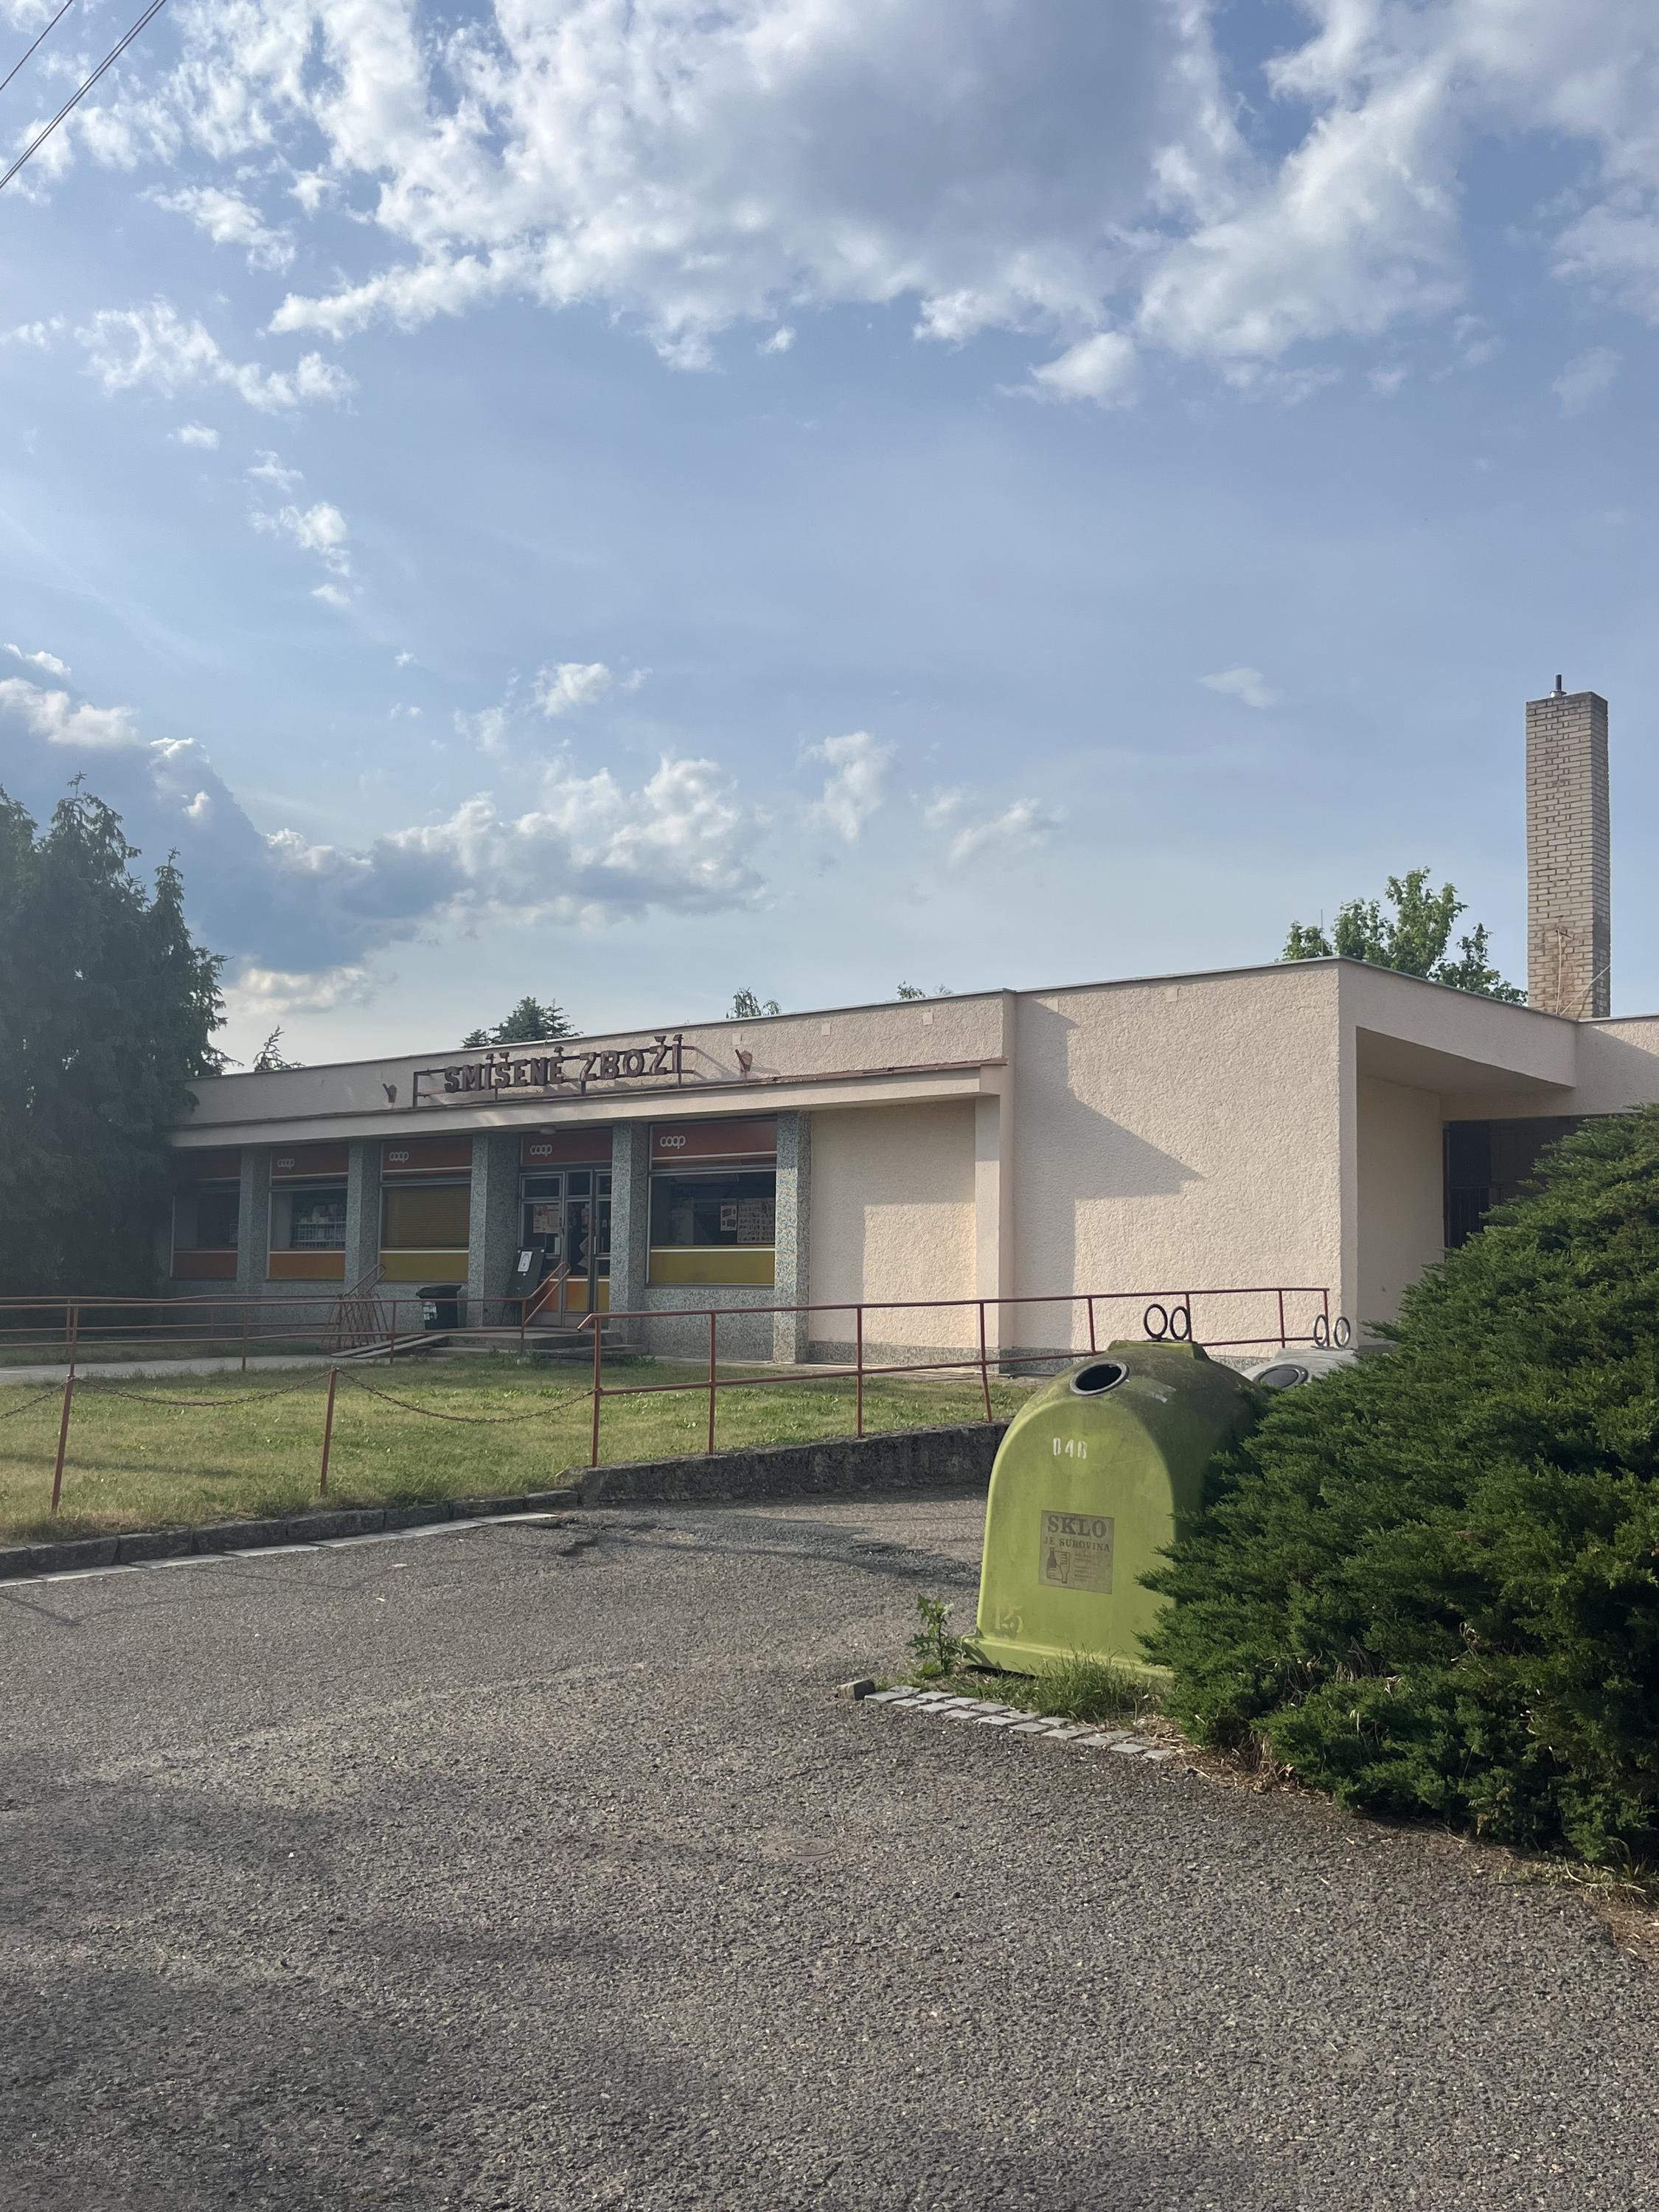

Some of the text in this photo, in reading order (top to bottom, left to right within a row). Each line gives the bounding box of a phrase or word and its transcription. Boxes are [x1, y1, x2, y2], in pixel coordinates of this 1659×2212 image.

[444, 1034, 682, 1093] SMÍŠENÉ ZBOŽÍ
[659, 1135, 686, 1149] coop
[389, 1151, 409, 1163] coop
[529, 1144, 553, 1156] coop
[276, 1158, 295, 1169] coop
[1048, 1515, 1107, 1538] SKLO
[1043, 1537, 1110, 1552] JE SUROVINA
